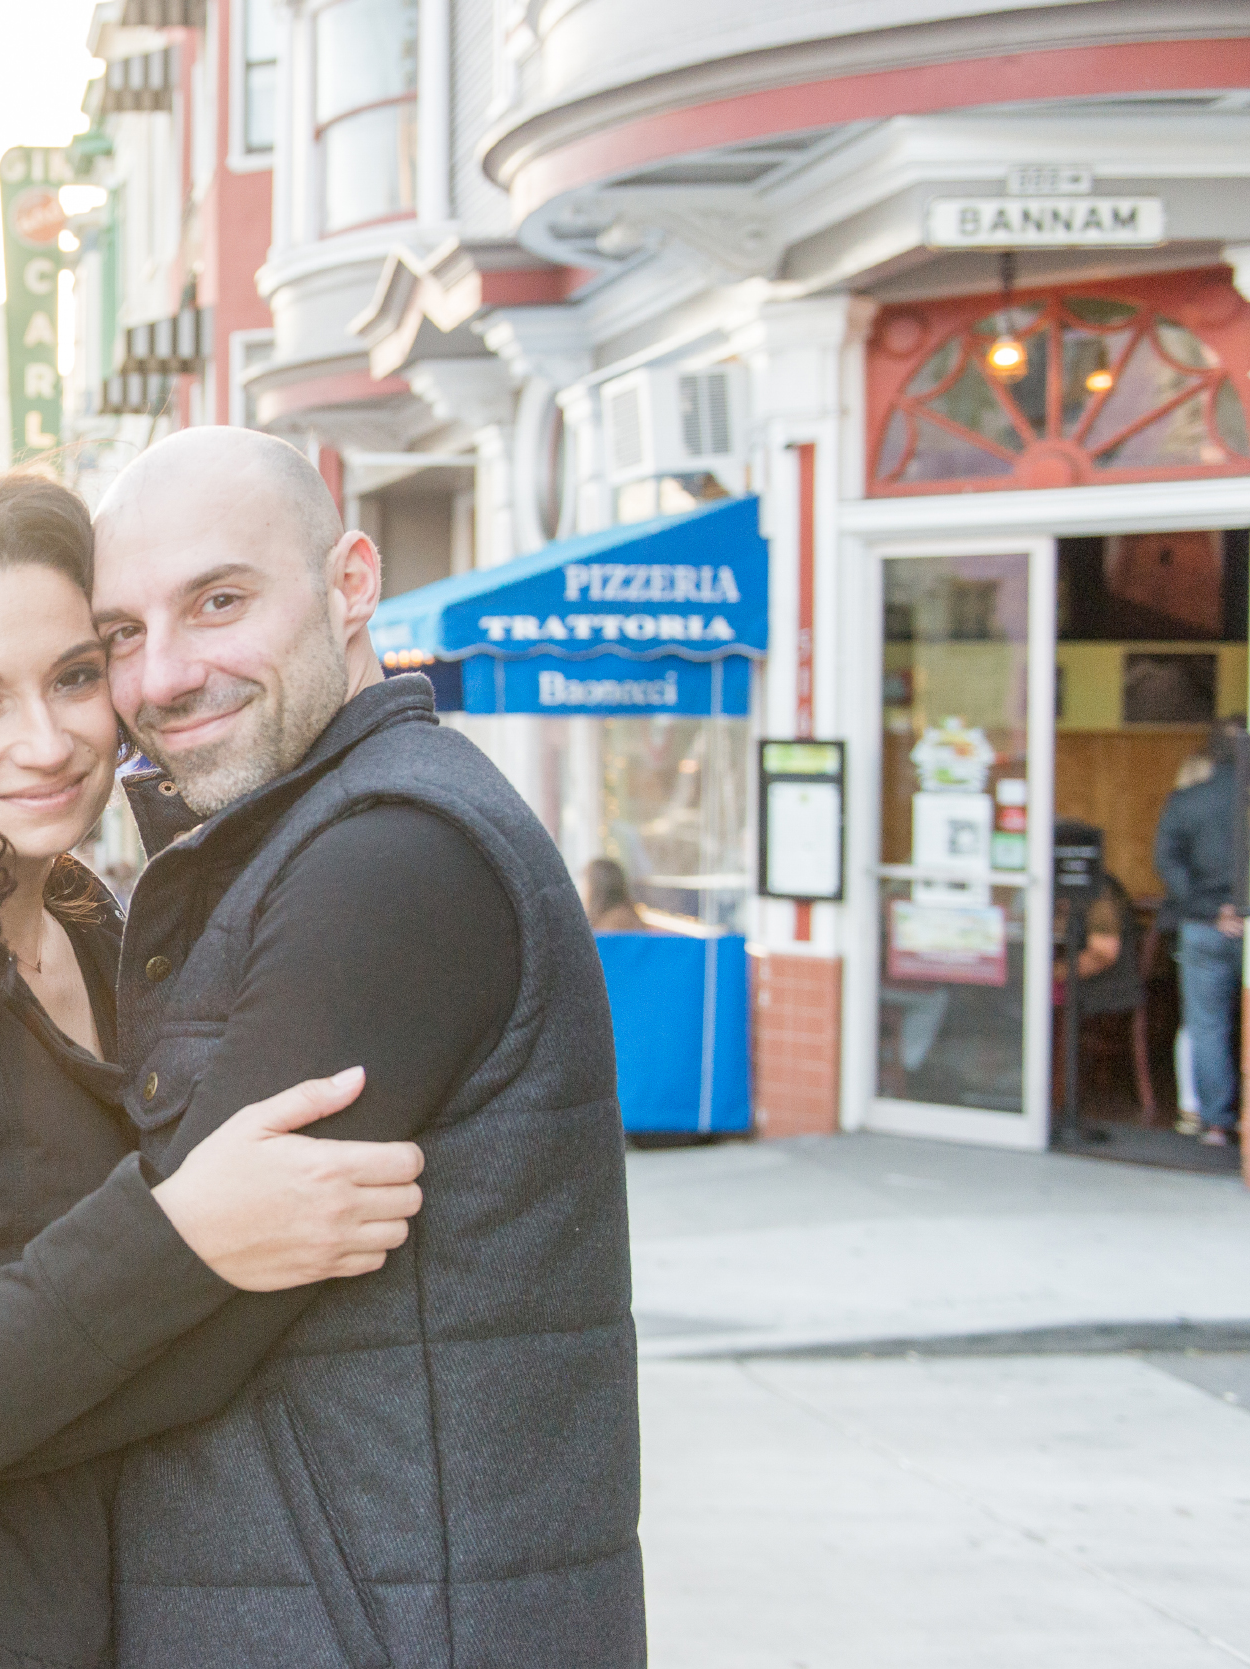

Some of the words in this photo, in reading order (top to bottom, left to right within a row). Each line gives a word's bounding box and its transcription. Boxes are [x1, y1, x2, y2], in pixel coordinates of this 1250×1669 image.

[959, 205, 1138, 236] BANNAM
[23, 256, 58, 478] CARL
[564, 563, 741, 604] PIZZERIA
[479, 613, 736, 641] TRATTORIA
